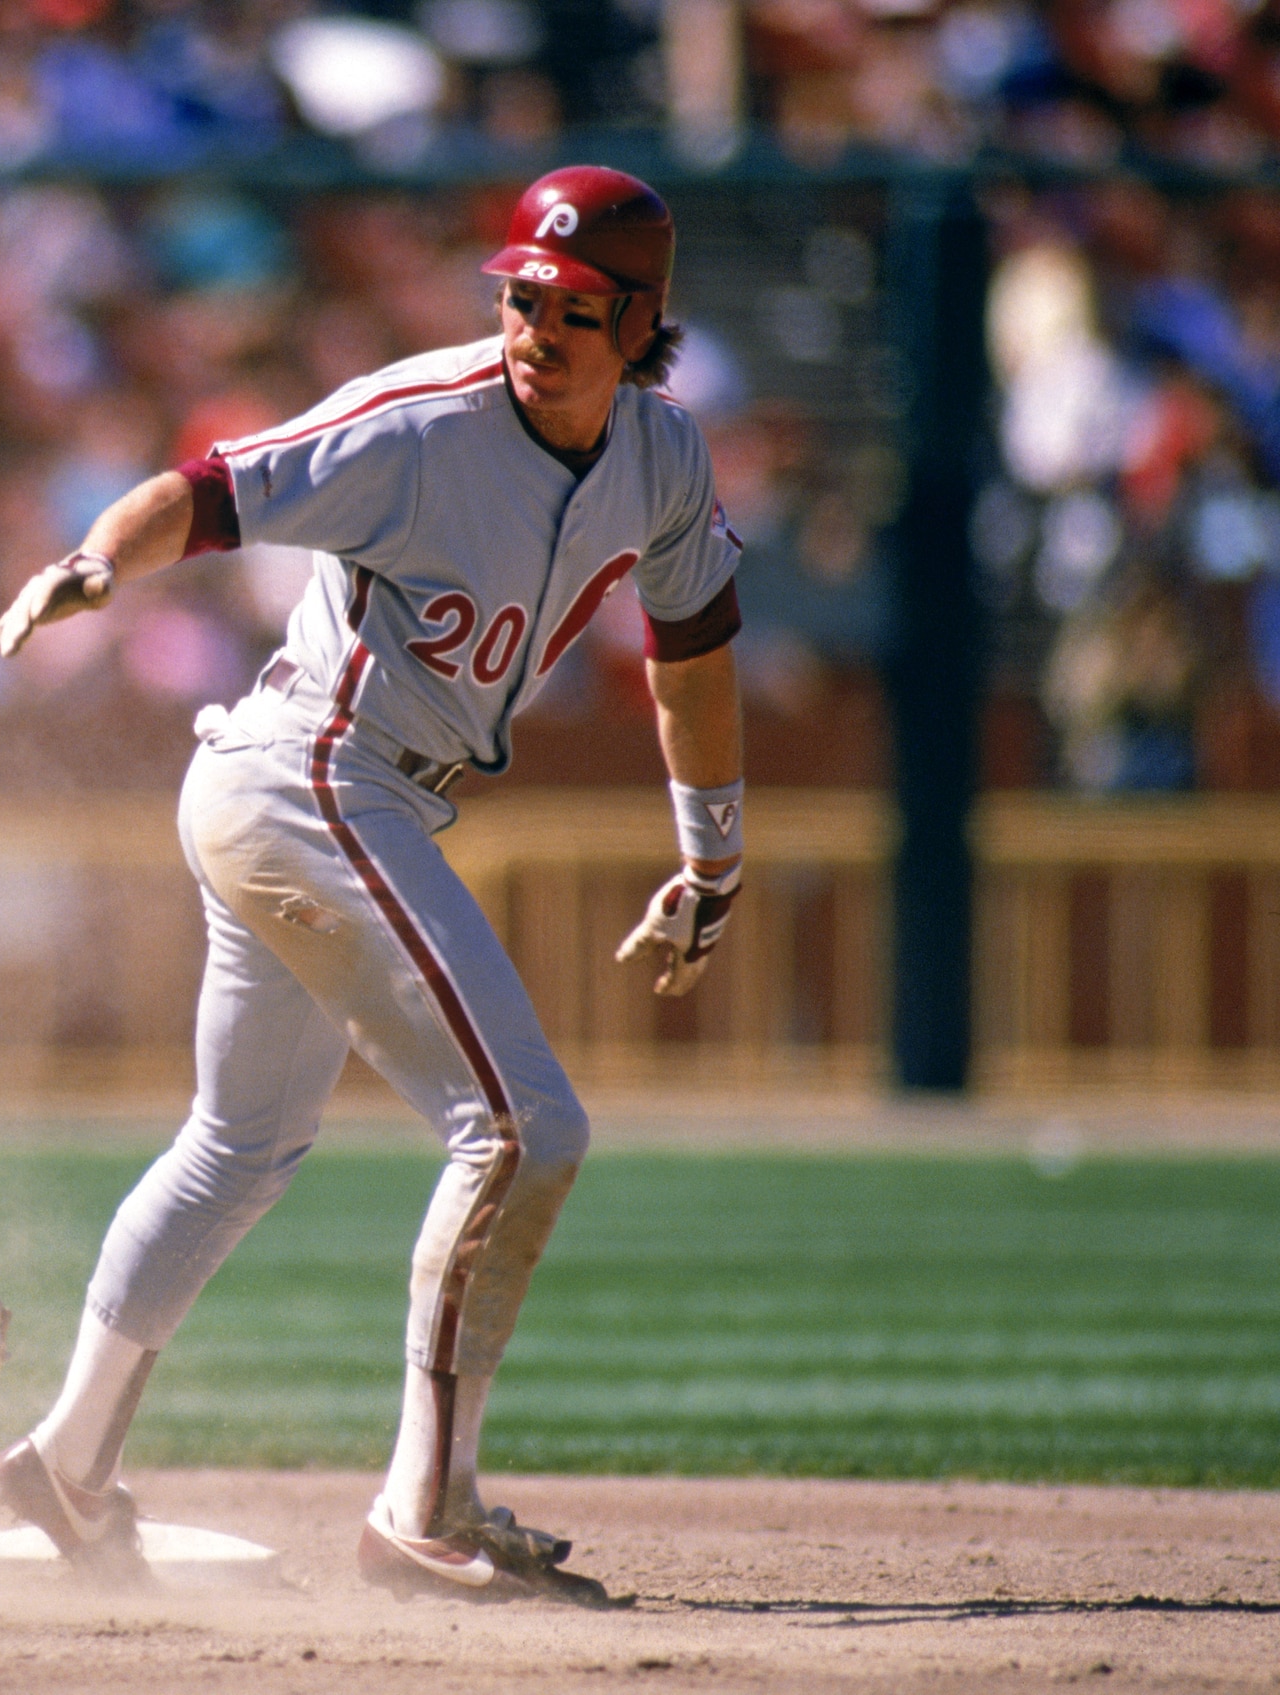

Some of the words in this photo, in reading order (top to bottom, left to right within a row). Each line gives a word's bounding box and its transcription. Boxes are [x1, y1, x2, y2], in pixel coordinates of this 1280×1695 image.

[535, 203, 579, 238] P
[518, 260, 559, 280] 20
[404, 590, 527, 688] 20
